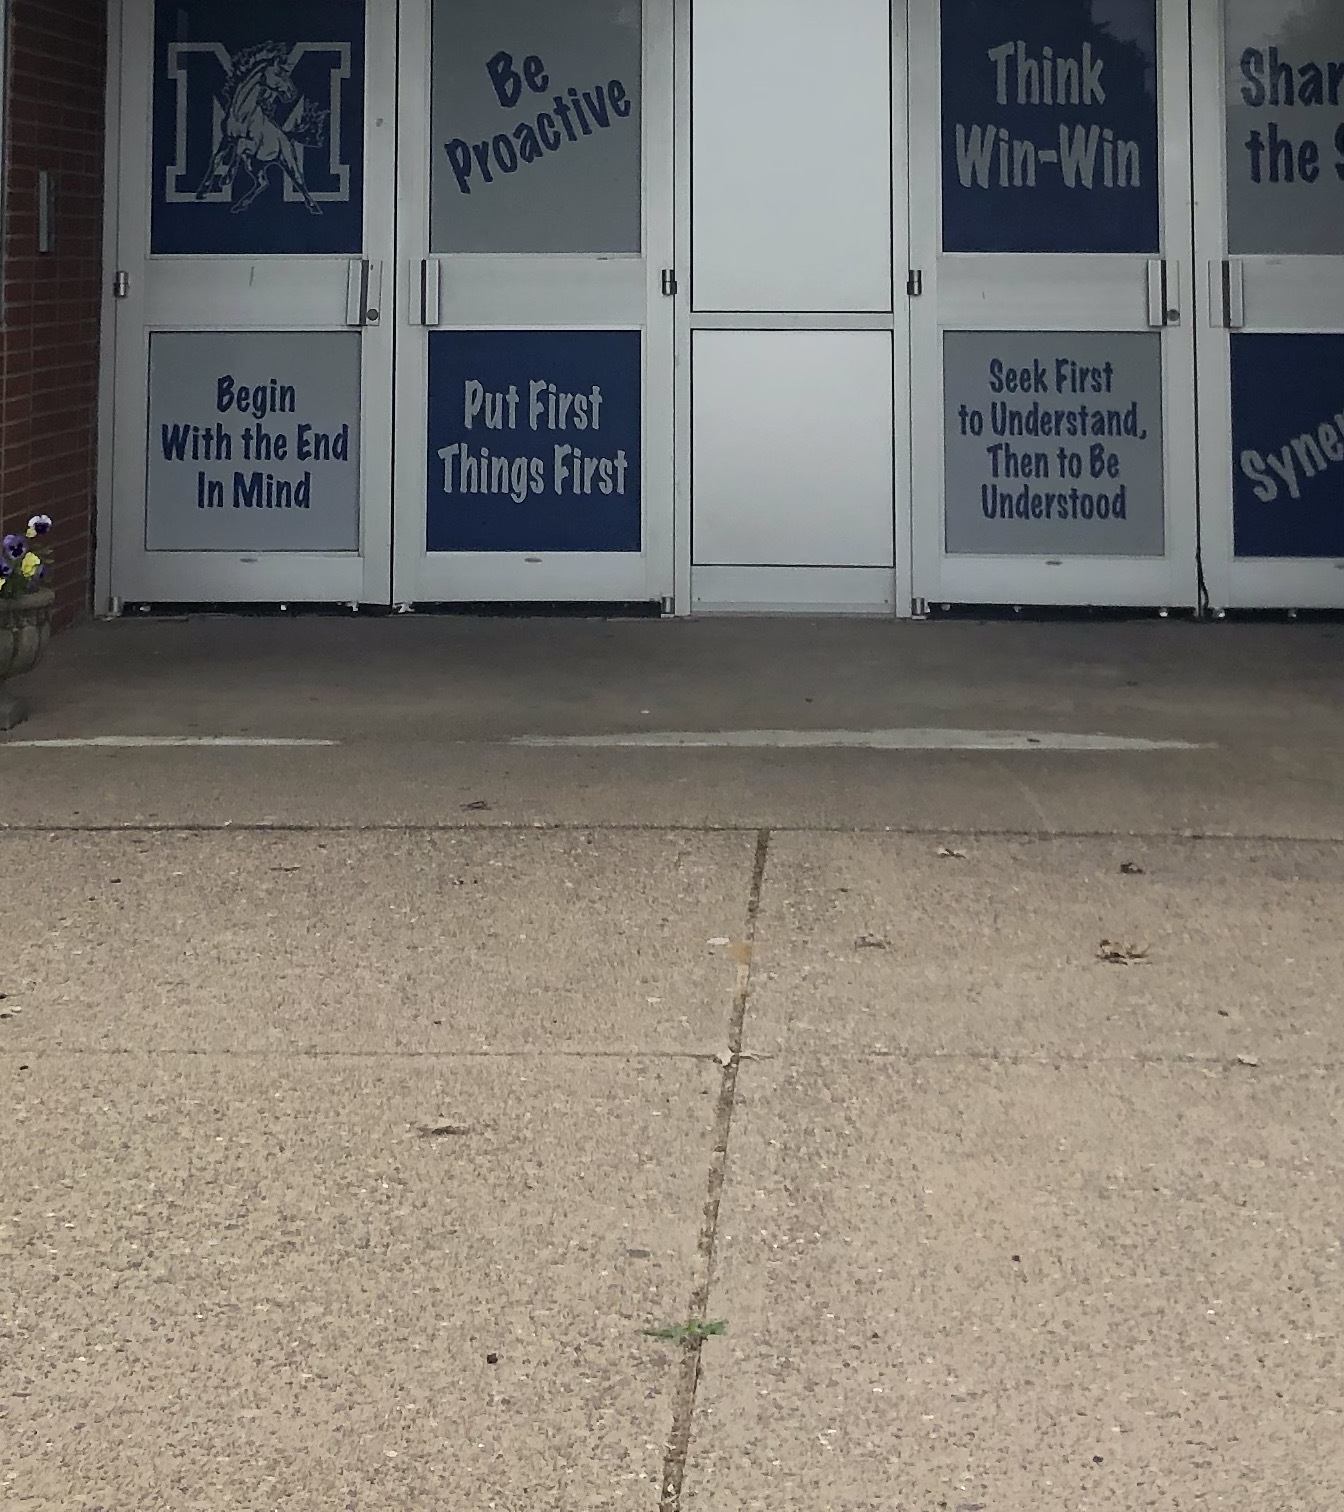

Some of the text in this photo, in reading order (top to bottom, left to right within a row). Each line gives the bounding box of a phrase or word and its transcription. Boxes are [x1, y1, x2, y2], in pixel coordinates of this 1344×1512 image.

[485, 51, 550, 108] Be
[987, 40, 1106, 106] Think
[443, 78, 632, 194] Proactive
[955, 124, 1141, 190] Win-Win
[1245, 123, 1320, 183] the
[216, 374, 296, 420] Begin
[988, 357, 1113, 394] Seek First
[463, 379, 604, 431] Put First
[958, 401, 1147, 441] to Understand,
[161, 423, 350, 462] With the End
[986, 443, 1120, 479] Then to Be
[197, 471, 312, 510] In Mind
[436, 443, 629, 504] Things First
[981, 484, 1128, 520] Understood
